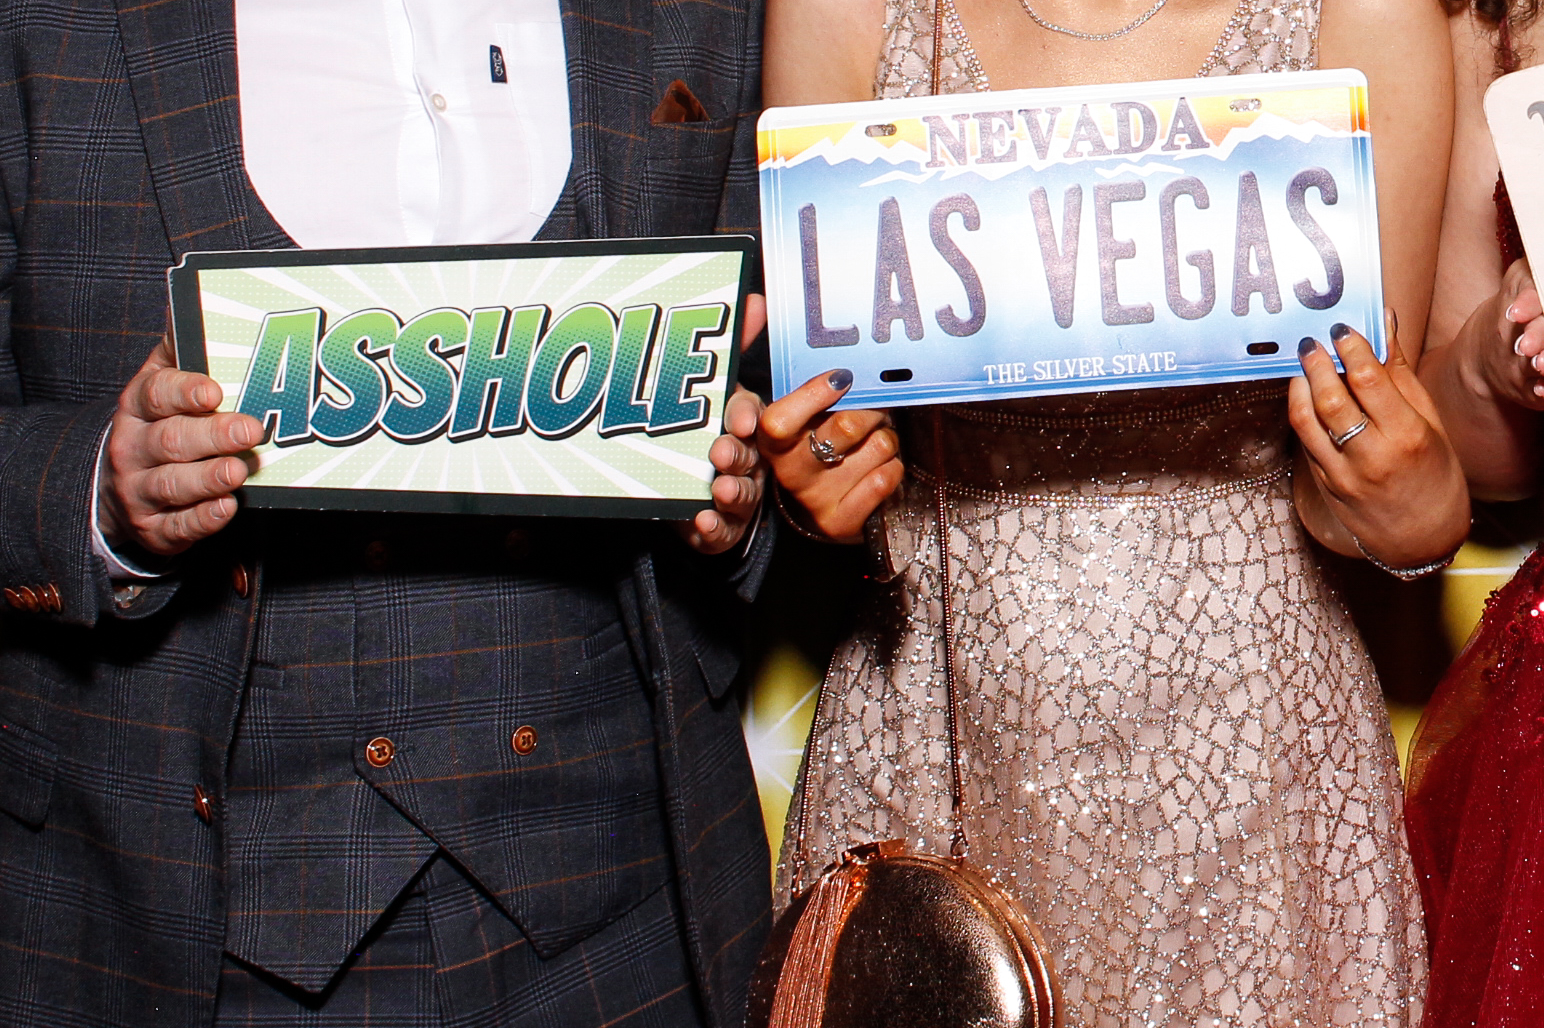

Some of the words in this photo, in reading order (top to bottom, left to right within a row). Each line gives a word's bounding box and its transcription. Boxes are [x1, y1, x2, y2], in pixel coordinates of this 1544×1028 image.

[922, 96, 1210, 168] NEVADA
[798, 192, 987, 349] LAS
[1028, 166, 1346, 329] VEGAS
[236, 302, 729, 448] ASSHOLE
[983, 361, 1028, 385] THE
[1033, 356, 1106, 381] SILVER
[1112, 351, 1178, 375] STATE
